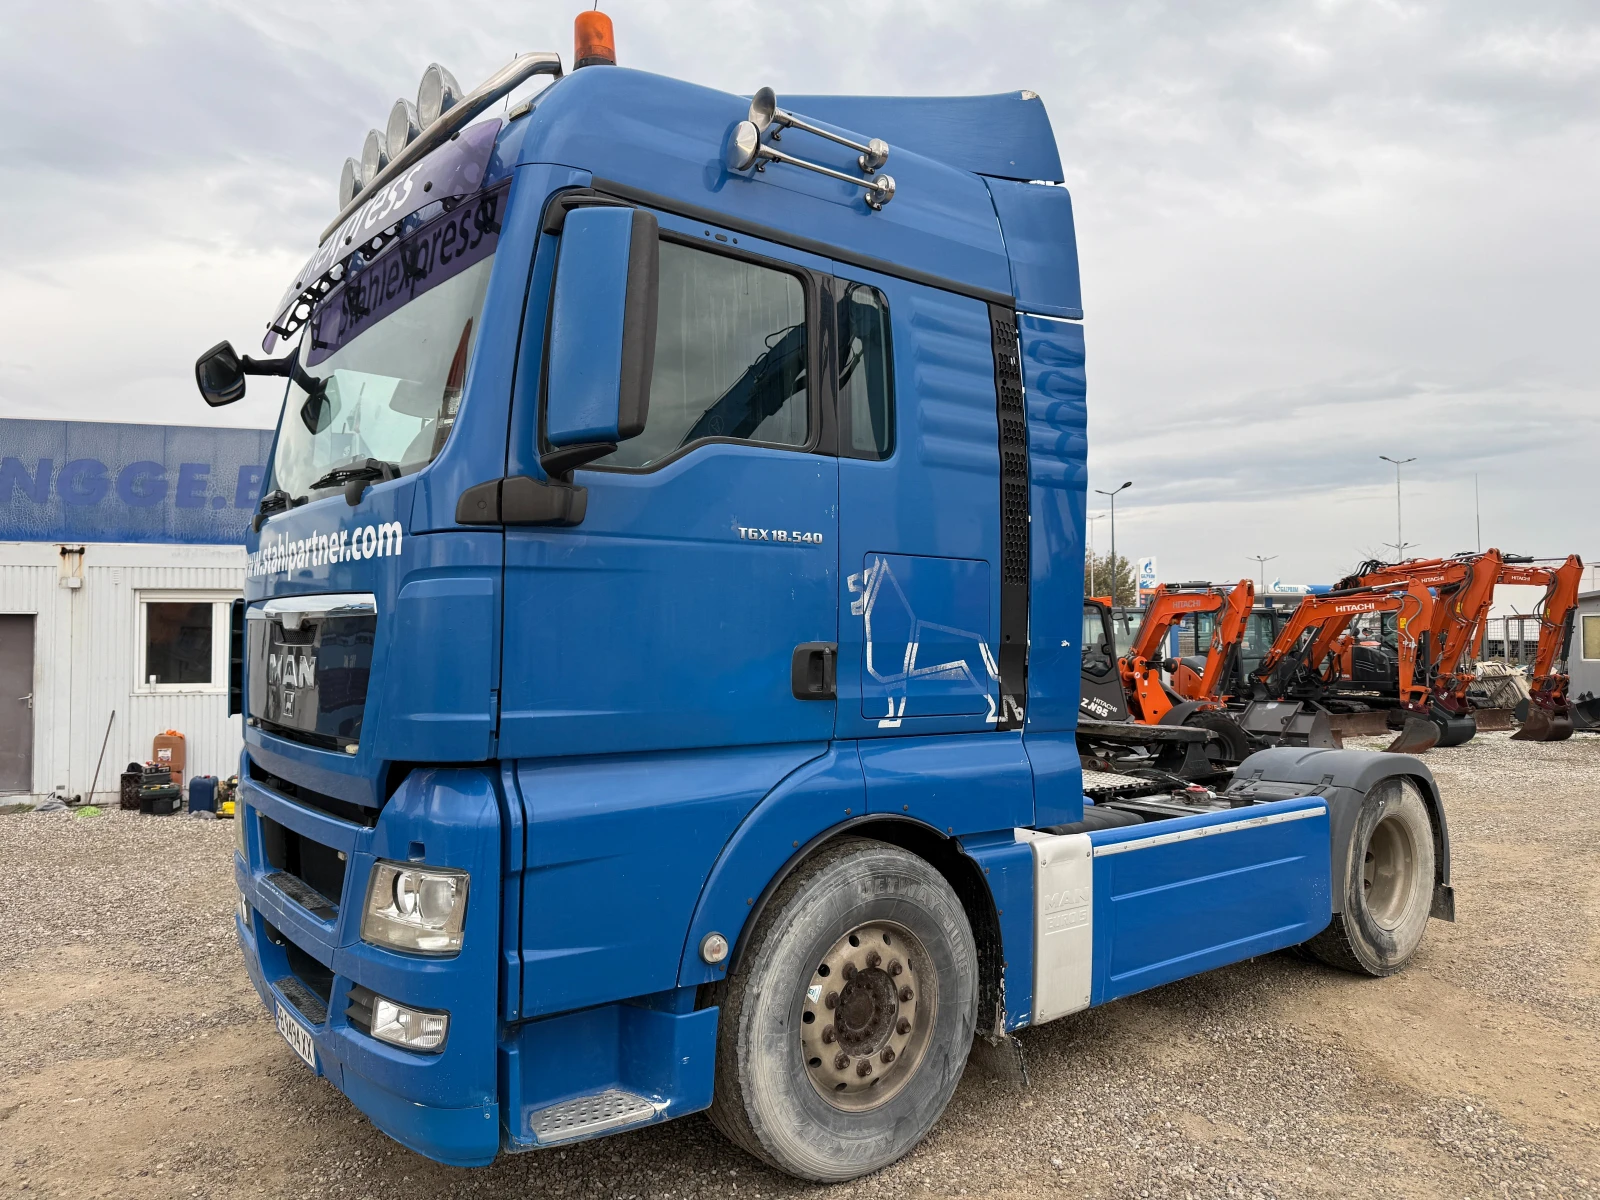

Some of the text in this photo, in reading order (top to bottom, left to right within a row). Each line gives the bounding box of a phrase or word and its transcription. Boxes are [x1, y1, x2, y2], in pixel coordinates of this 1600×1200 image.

[738, 527, 823, 544] TGX 18.540
[1172, 600, 1202, 609] HITACHI
[1335, 603, 1375, 613] HITACHI
[269, 653, 316, 689] MAN
[1093, 697, 1117, 713] HITACHI
[1044, 886, 1089, 911] MAN
